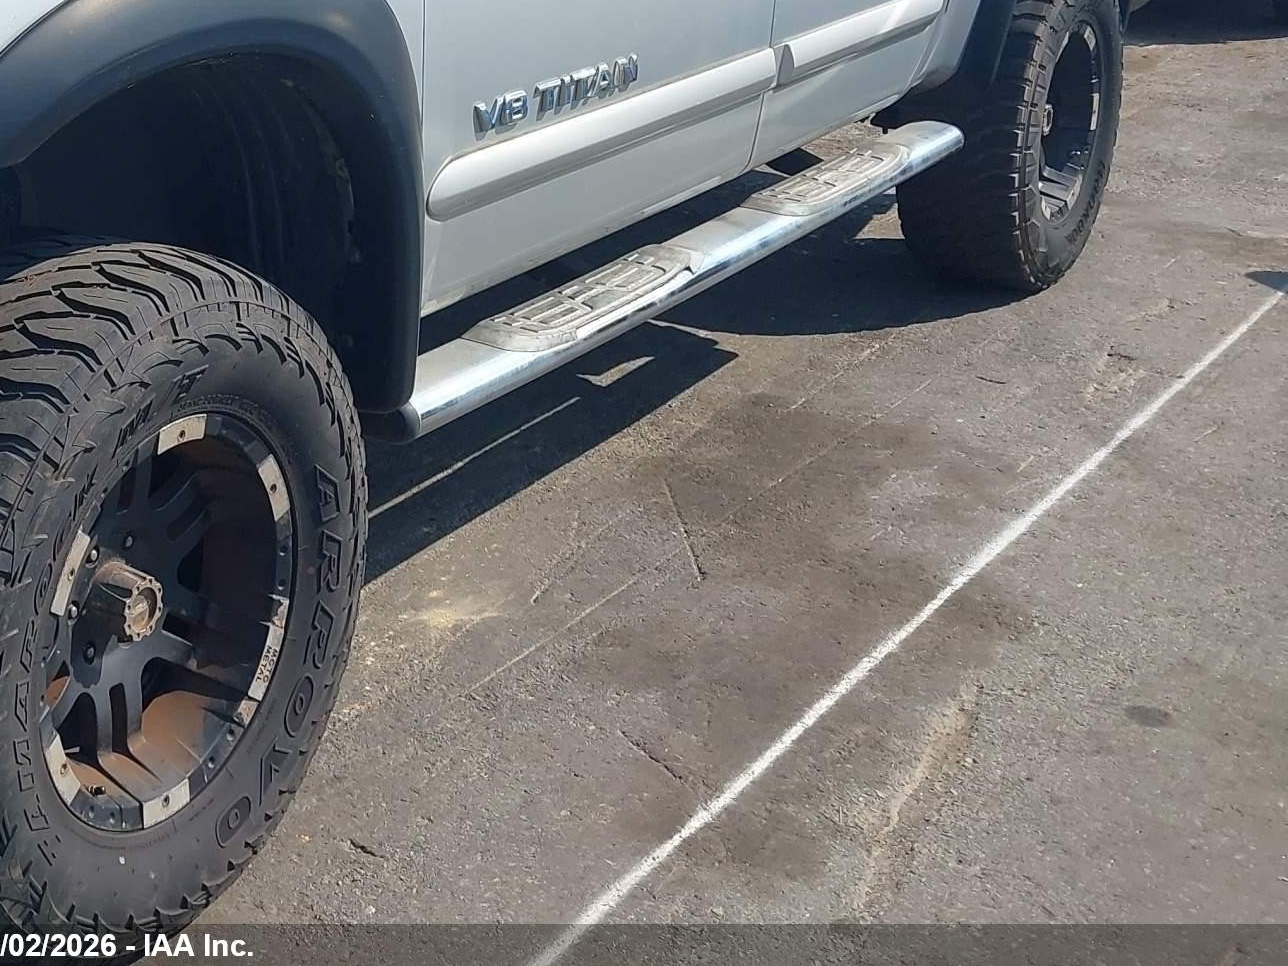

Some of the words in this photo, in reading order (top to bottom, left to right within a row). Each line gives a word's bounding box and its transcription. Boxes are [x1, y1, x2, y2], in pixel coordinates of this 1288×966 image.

[473, 90, 528, 135] V8
[533, 53, 638, 114] TITAN
[216, 464, 342, 849] ARROYO
[255, 645, 272, 682] METAL
[263, 648, 279, 683] MOTO
